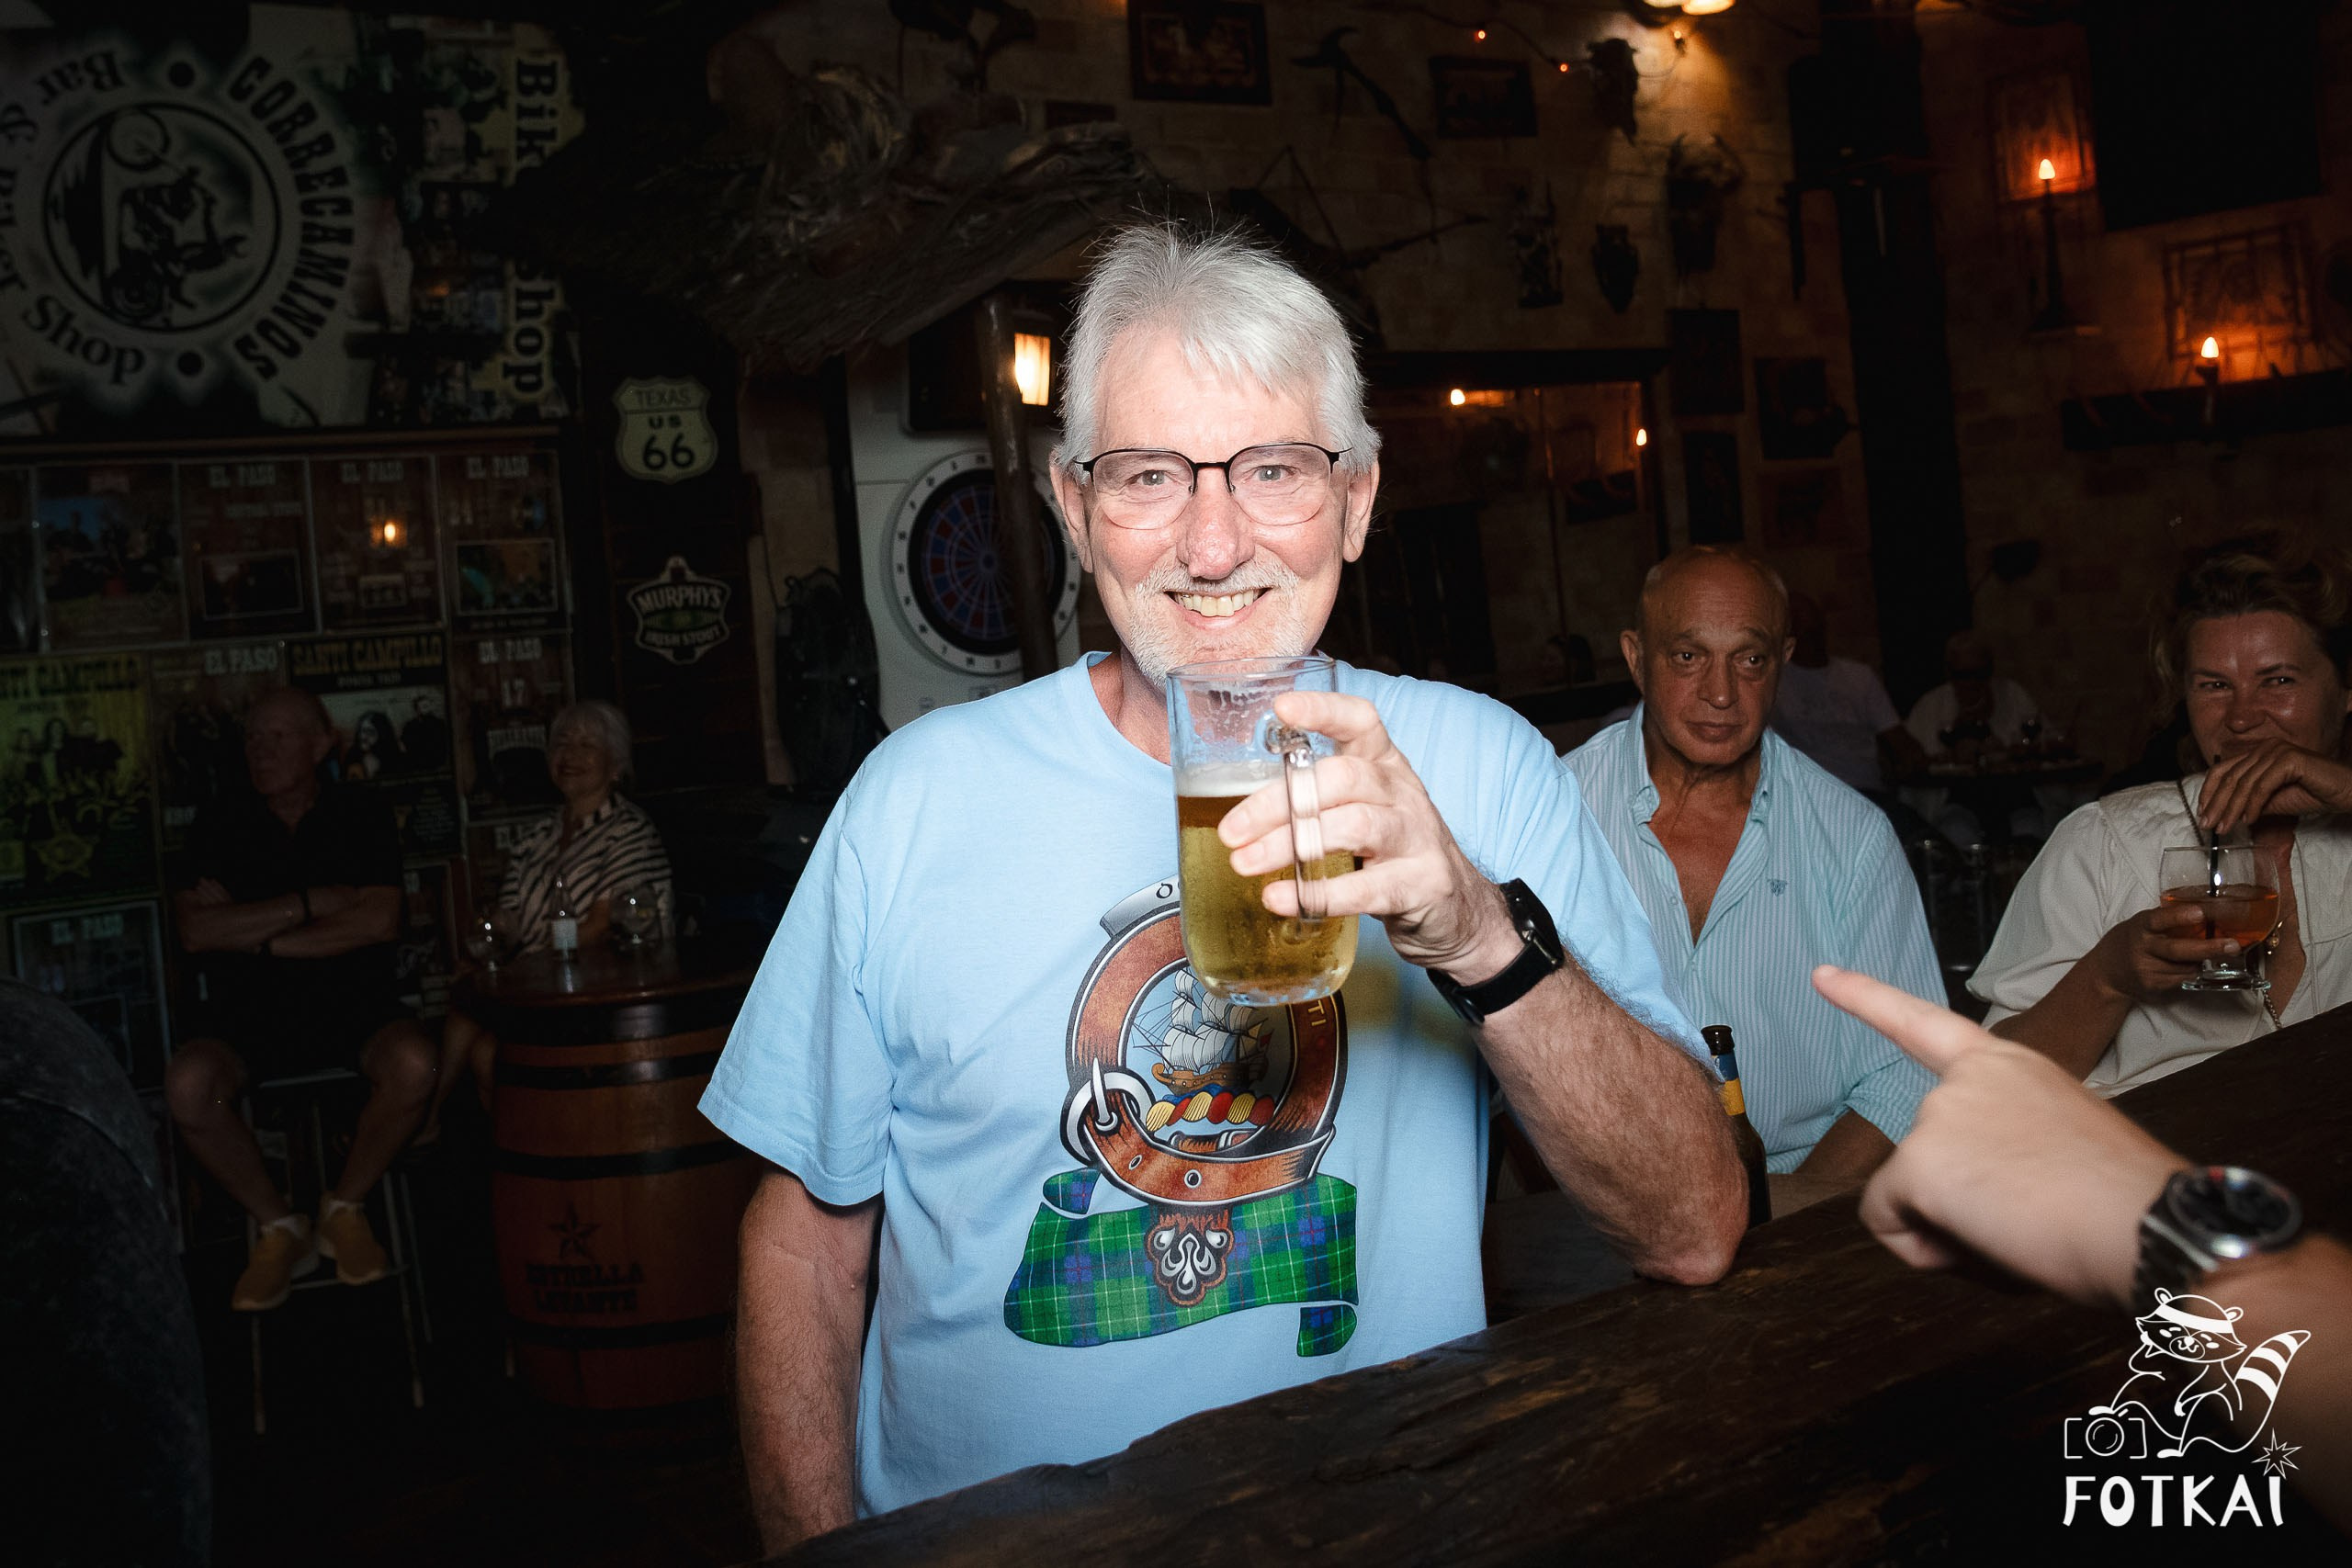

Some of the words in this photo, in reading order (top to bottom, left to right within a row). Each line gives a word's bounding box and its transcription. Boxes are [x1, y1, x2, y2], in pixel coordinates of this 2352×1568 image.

[35, 51, 124, 106] Bar
[516, 60, 558, 163] Bik
[229, 56, 355, 379] CORRECAMINOS
[22, 294, 146, 386] Shop
[636, 389, 691, 408] TEXAS
[644, 434, 695, 471] 66
[204, 649, 226, 675] EL
[229, 646, 278, 673] PASO
[1307, 998, 1327, 1027] TI
